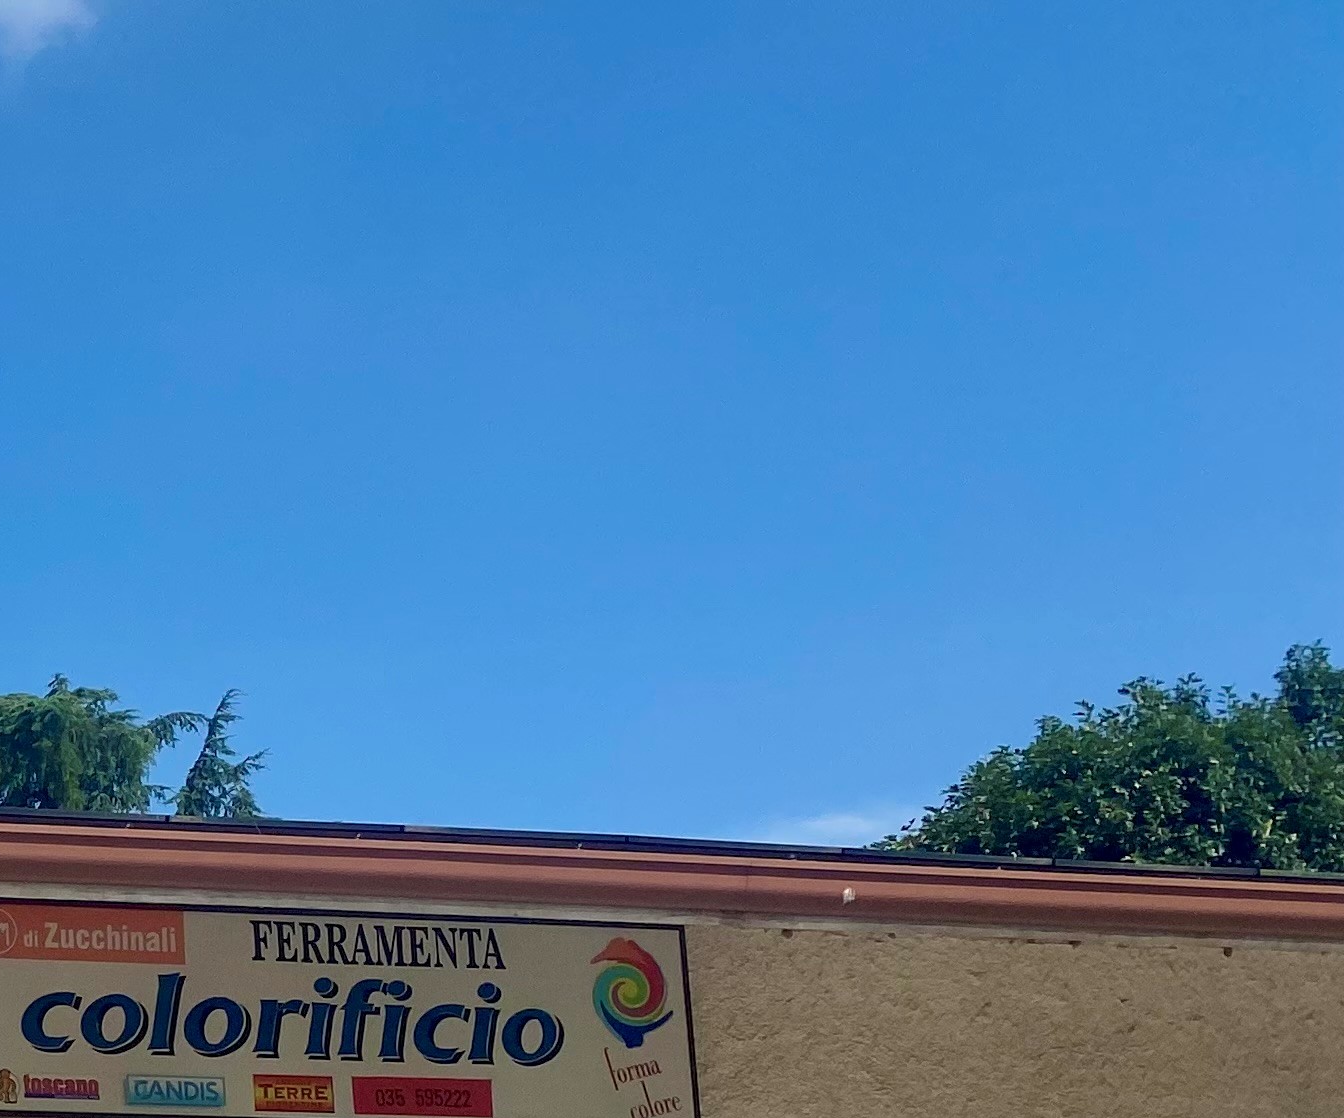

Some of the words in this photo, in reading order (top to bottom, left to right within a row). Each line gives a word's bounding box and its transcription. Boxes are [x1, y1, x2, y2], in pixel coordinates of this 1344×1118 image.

[23, 930, 39, 948] di
[44, 922, 177, 953] Zucchinali
[249, 919, 507, 970] FERRAMENTA
[20, 972, 565, 1067] colorificio
[604, 1047, 662, 1091] forma
[23, 1074, 100, 1097] toscano
[258, 1083, 329, 1101] TERRE
[375, 1088, 406, 1107] 035
[415, 1088, 473, 1108] 595222
